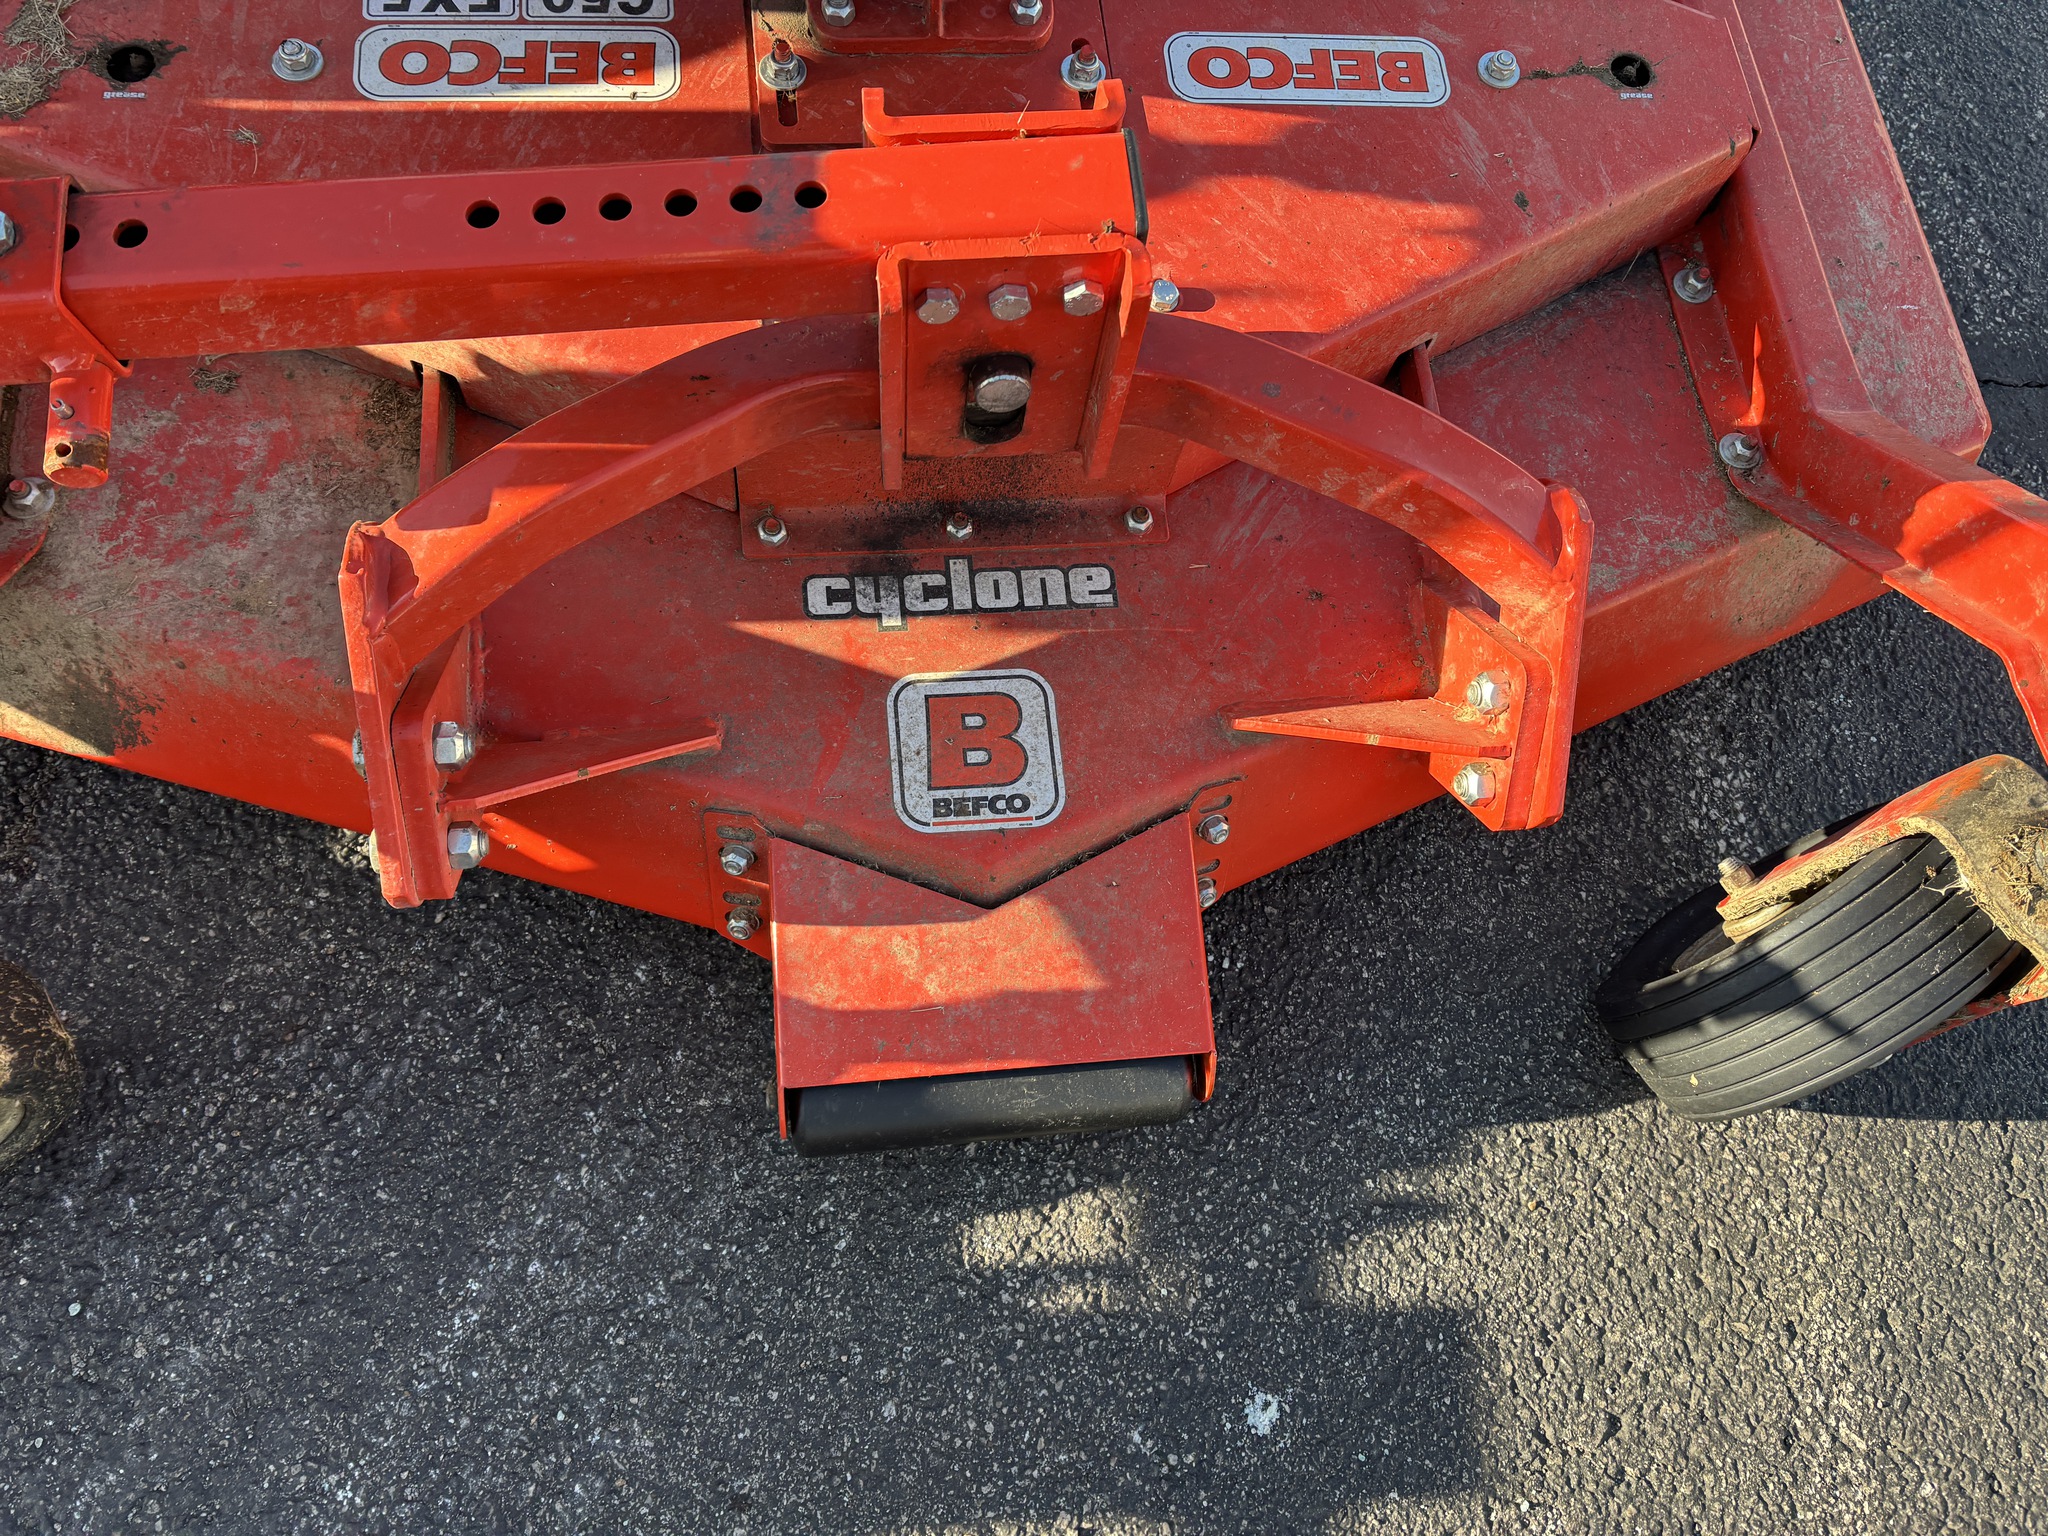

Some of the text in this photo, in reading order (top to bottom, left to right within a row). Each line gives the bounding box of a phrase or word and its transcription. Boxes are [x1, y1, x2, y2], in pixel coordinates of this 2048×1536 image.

[379, 40, 656, 85] BEFCO
[1187, 46, 1430, 93] BEFCO
[103, 91, 147, 99] grease
[804, 556, 1117, 629] cyclone
[924, 691, 1029, 791] B
[932, 793, 1031, 818] BEFCO
